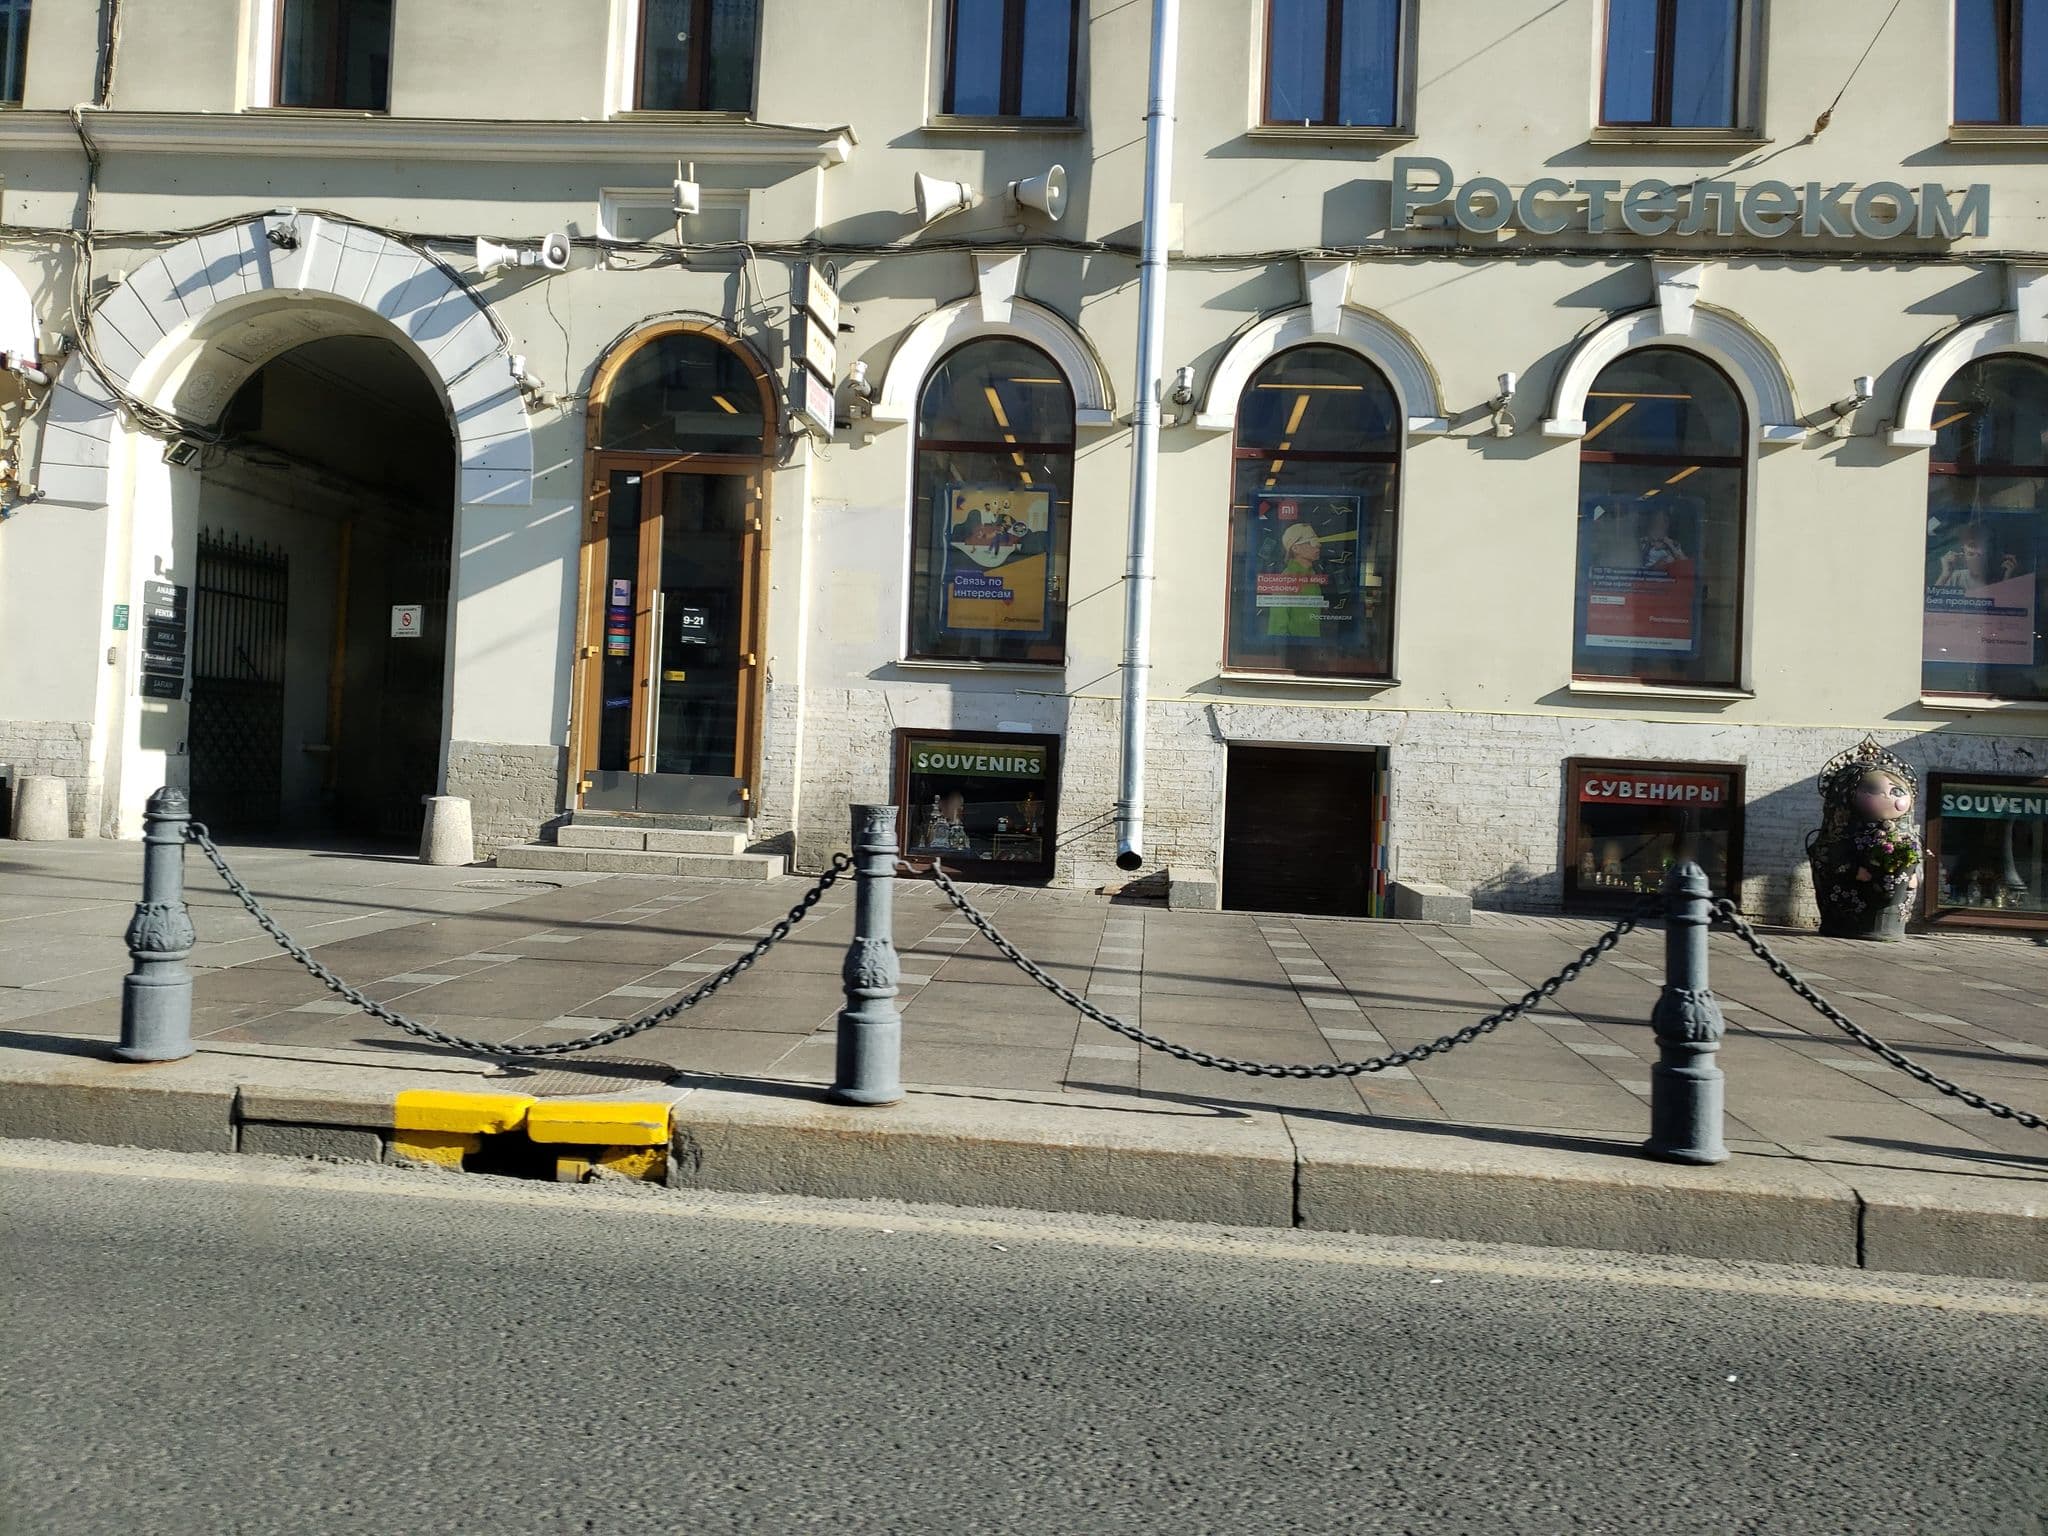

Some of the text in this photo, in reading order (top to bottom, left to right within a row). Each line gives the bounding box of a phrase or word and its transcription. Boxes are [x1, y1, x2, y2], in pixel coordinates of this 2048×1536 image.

[1389, 156, 1993, 239] Ростелеком
[955, 576, 1002, 587] Связь по
[954, 590, 1011, 599] интересам
[683, 615, 704, 625] 9-21
[917, 751, 1042, 775] SOUVENIRS
[1584, 779, 1720, 803] СУВЕНИРЫ
